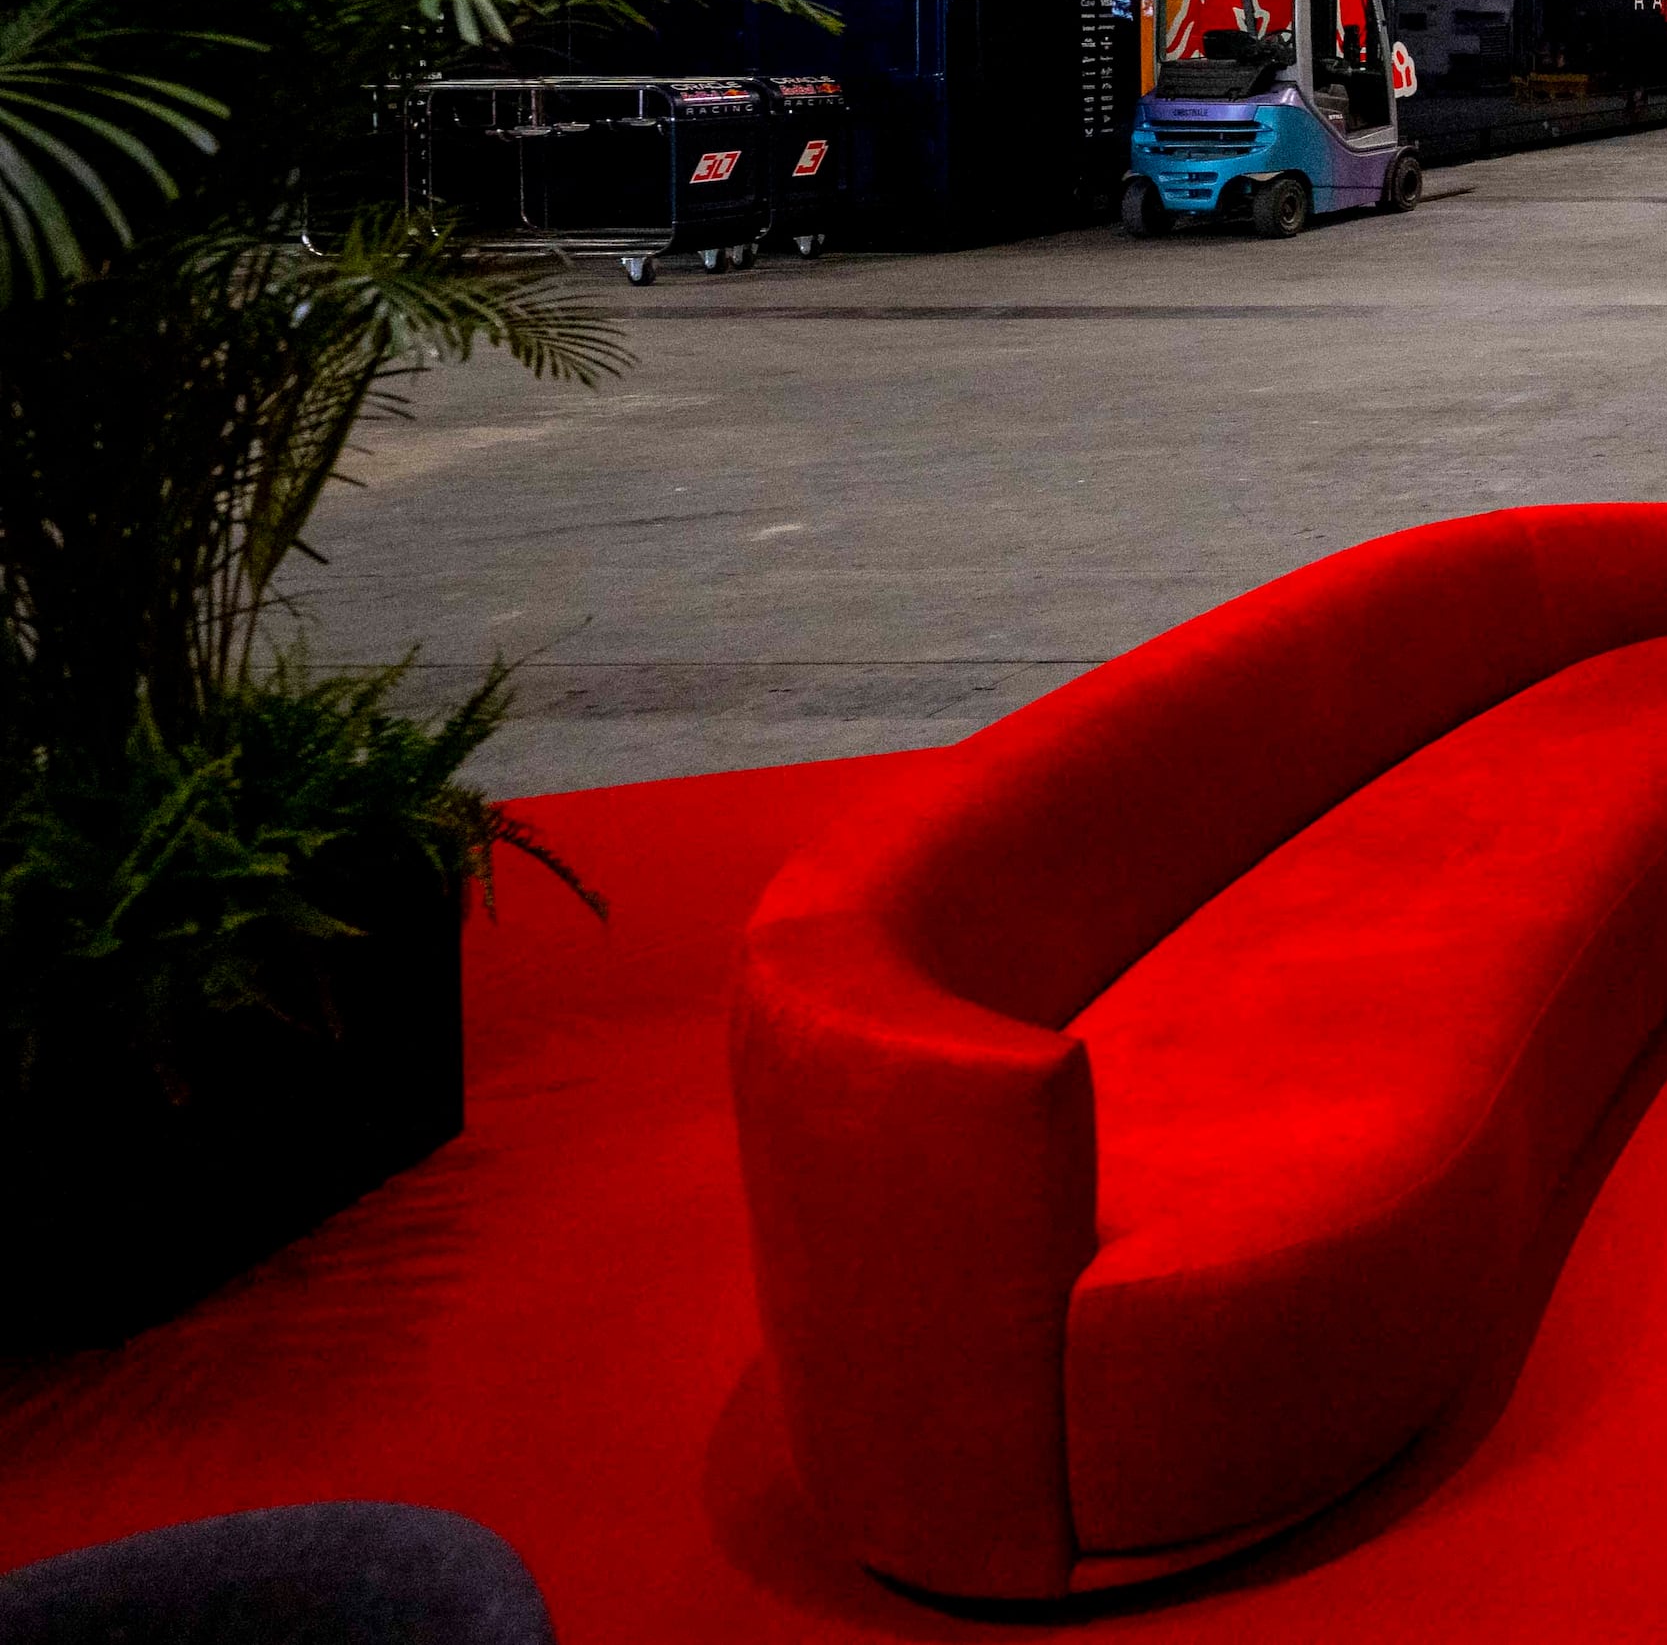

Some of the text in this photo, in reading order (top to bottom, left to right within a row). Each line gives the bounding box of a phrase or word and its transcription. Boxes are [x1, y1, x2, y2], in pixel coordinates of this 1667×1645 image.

[671, 81, 742, 91] ORACLE
[784, 98, 844, 107] RACING
[686, 105, 753, 115] RACING
